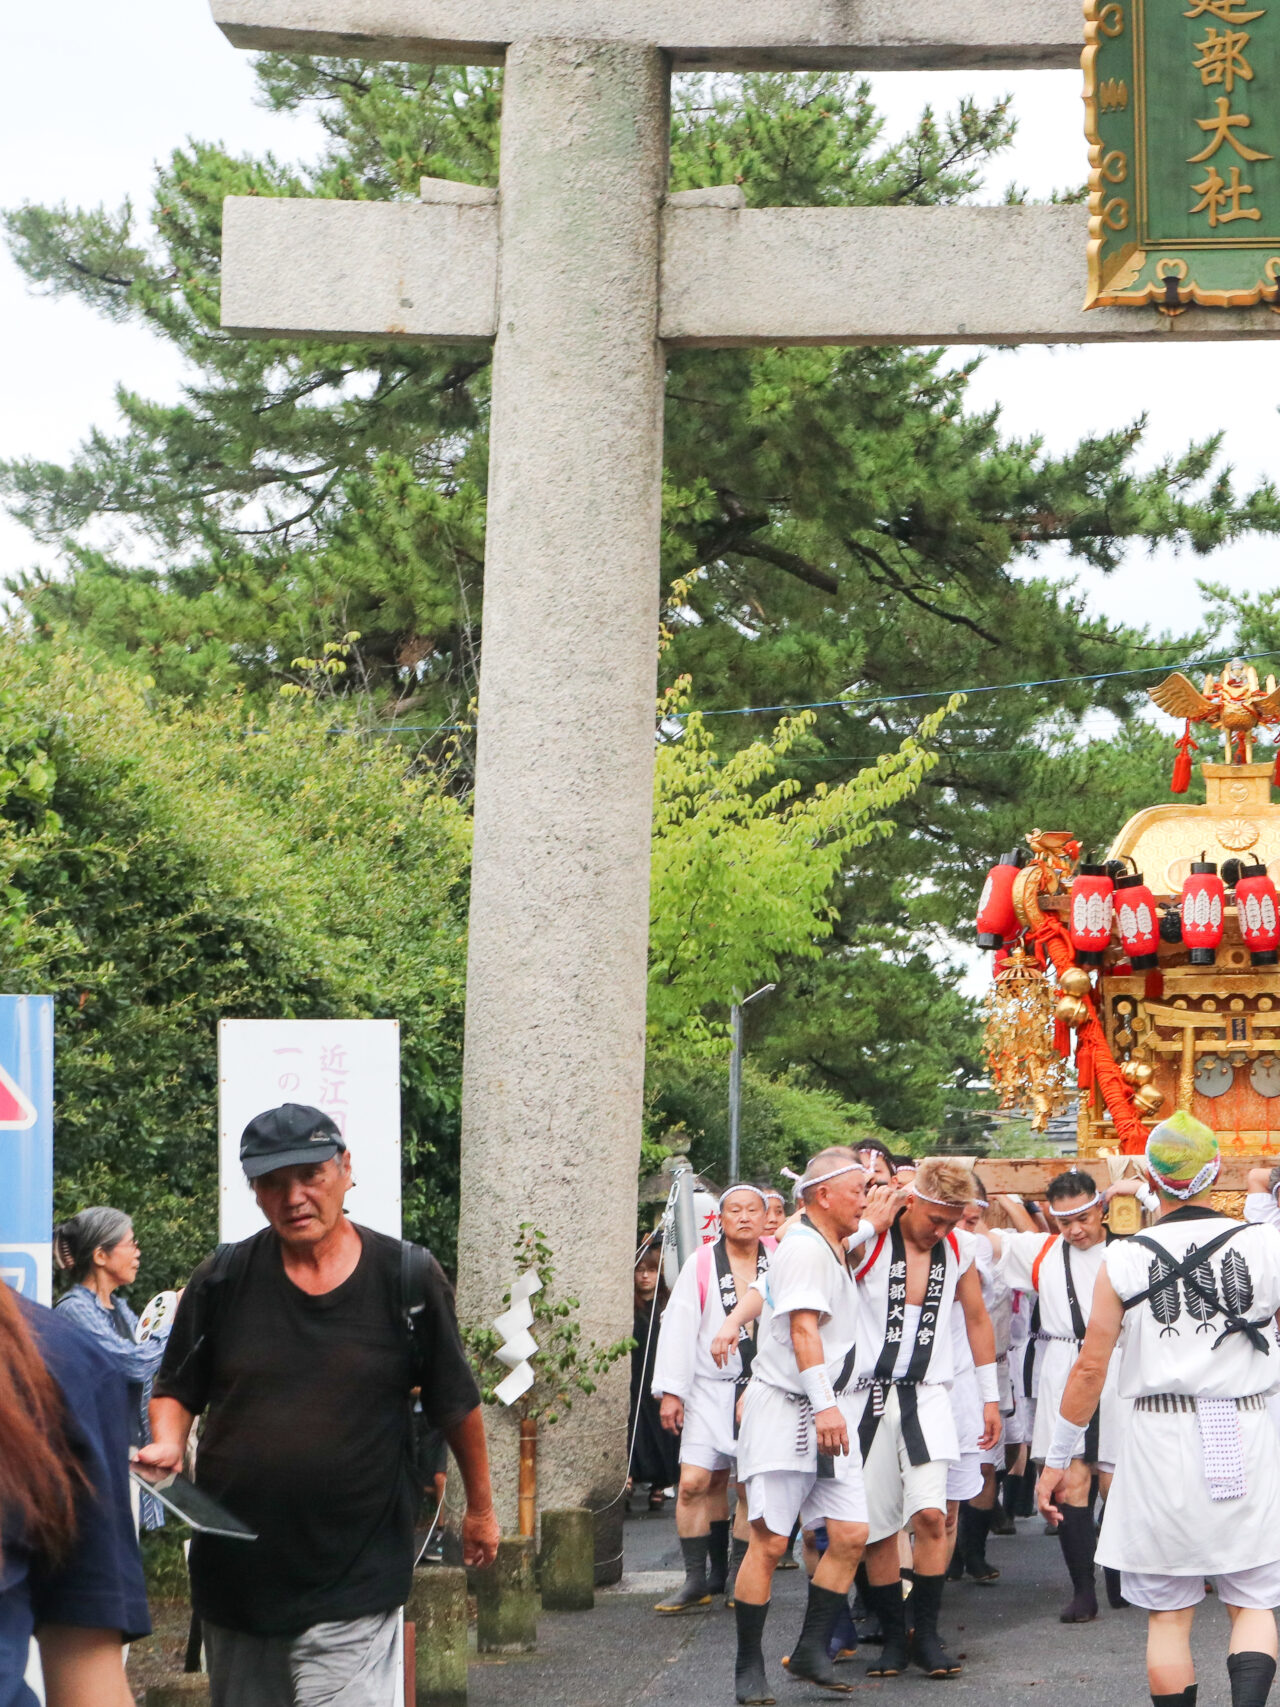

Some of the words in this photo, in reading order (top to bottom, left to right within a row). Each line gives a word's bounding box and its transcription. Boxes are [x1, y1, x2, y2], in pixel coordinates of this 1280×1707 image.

[273, 1047, 302, 1092] 一の
[885, 1260, 906, 1343] 建部大社
[917, 1262, 945, 1345] 近江一の宮
